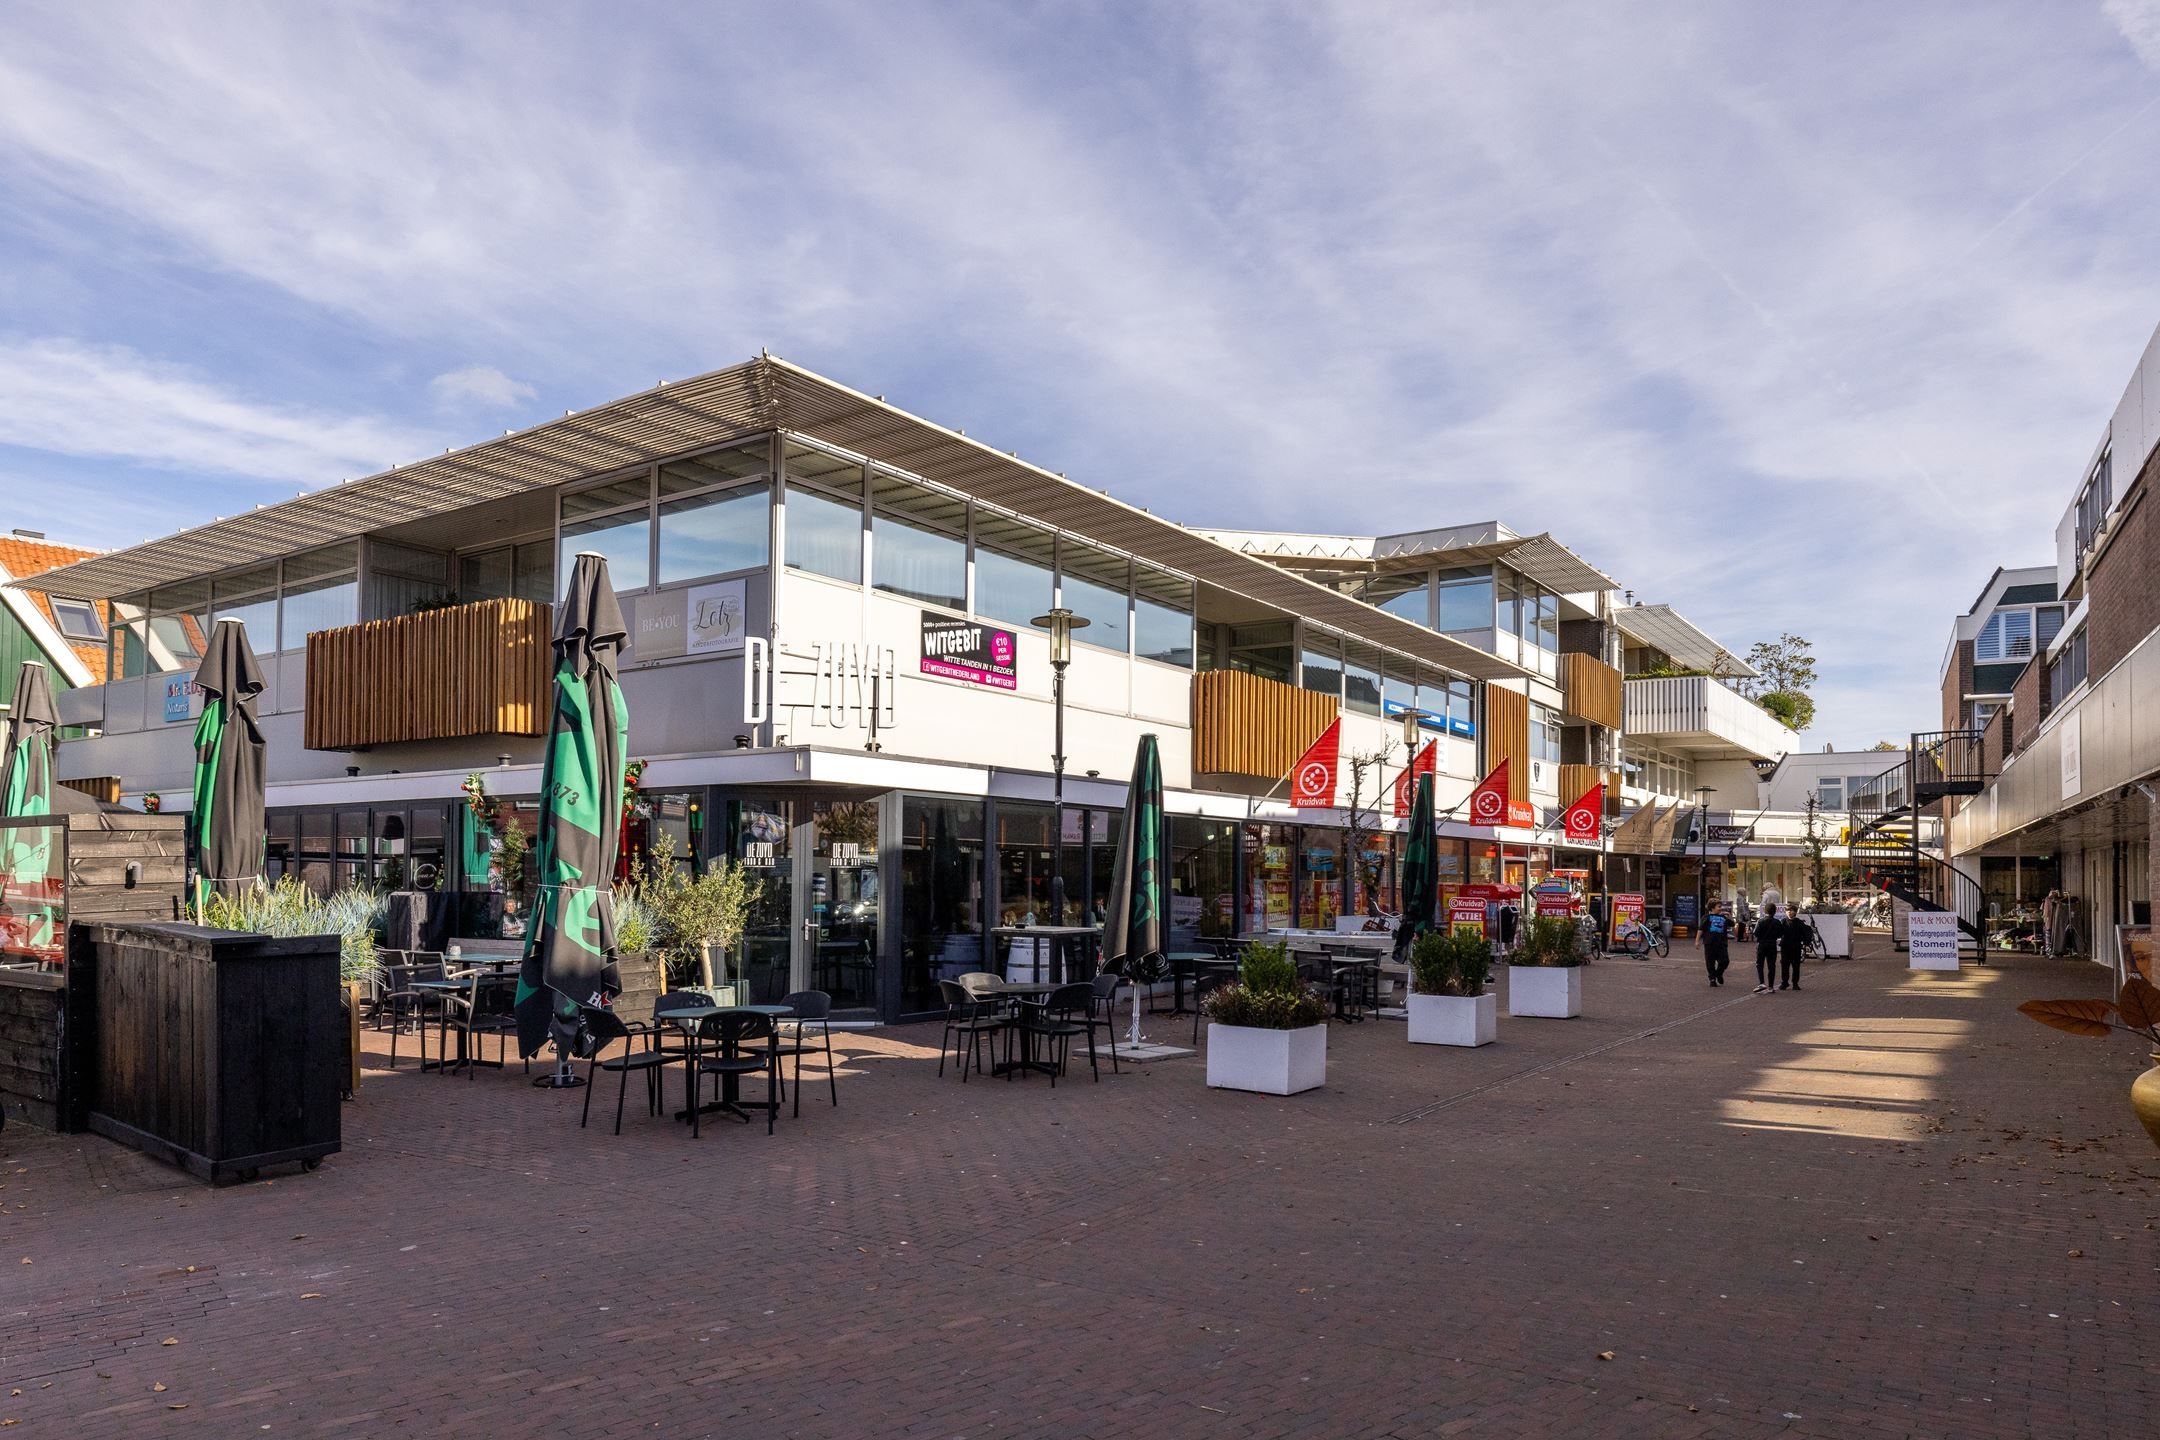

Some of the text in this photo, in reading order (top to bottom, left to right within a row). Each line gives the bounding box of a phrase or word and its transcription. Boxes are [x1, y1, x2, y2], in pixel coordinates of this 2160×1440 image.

[924, 628, 981, 655] WITGEBIT
[995, 637, 1008, 647] €10
[943, 654, 961, 665] WITTE
[960, 658, 983, 671] TANDEN
[992, 665, 1014, 676] BEZOEK
[930, 664, 980, 681] WITGEBITNEDERLAND
[743, 636, 900, 729] DE ZUYD
[551, 781, 580, 807] 873
[1296, 797, 1327, 806] Kruidvat
[1512, 804, 1533, 823] Kruidvat
[1475, 817, 1502, 825] Kruidvat
[1569, 831, 1594, 839] Kruidvat
[746, 842, 773, 858] DE ZUYD
[832, 842, 858, 858] DE ZUYD
[1458, 899, 1485, 908] Kruidvat
[1545, 895, 1568, 904] Kruidvat
[1453, 912, 1482, 921] ACTIE!
[1541, 908, 1567, 917] ACTIE!
[1910, 916, 1956, 925] MAL & MOOI
[1911, 928, 1956, 939] Kledingreparatie
[1912, 939, 1956, 950] Stomerij
[1911, 949, 1958, 960] Schoenenreparatie
